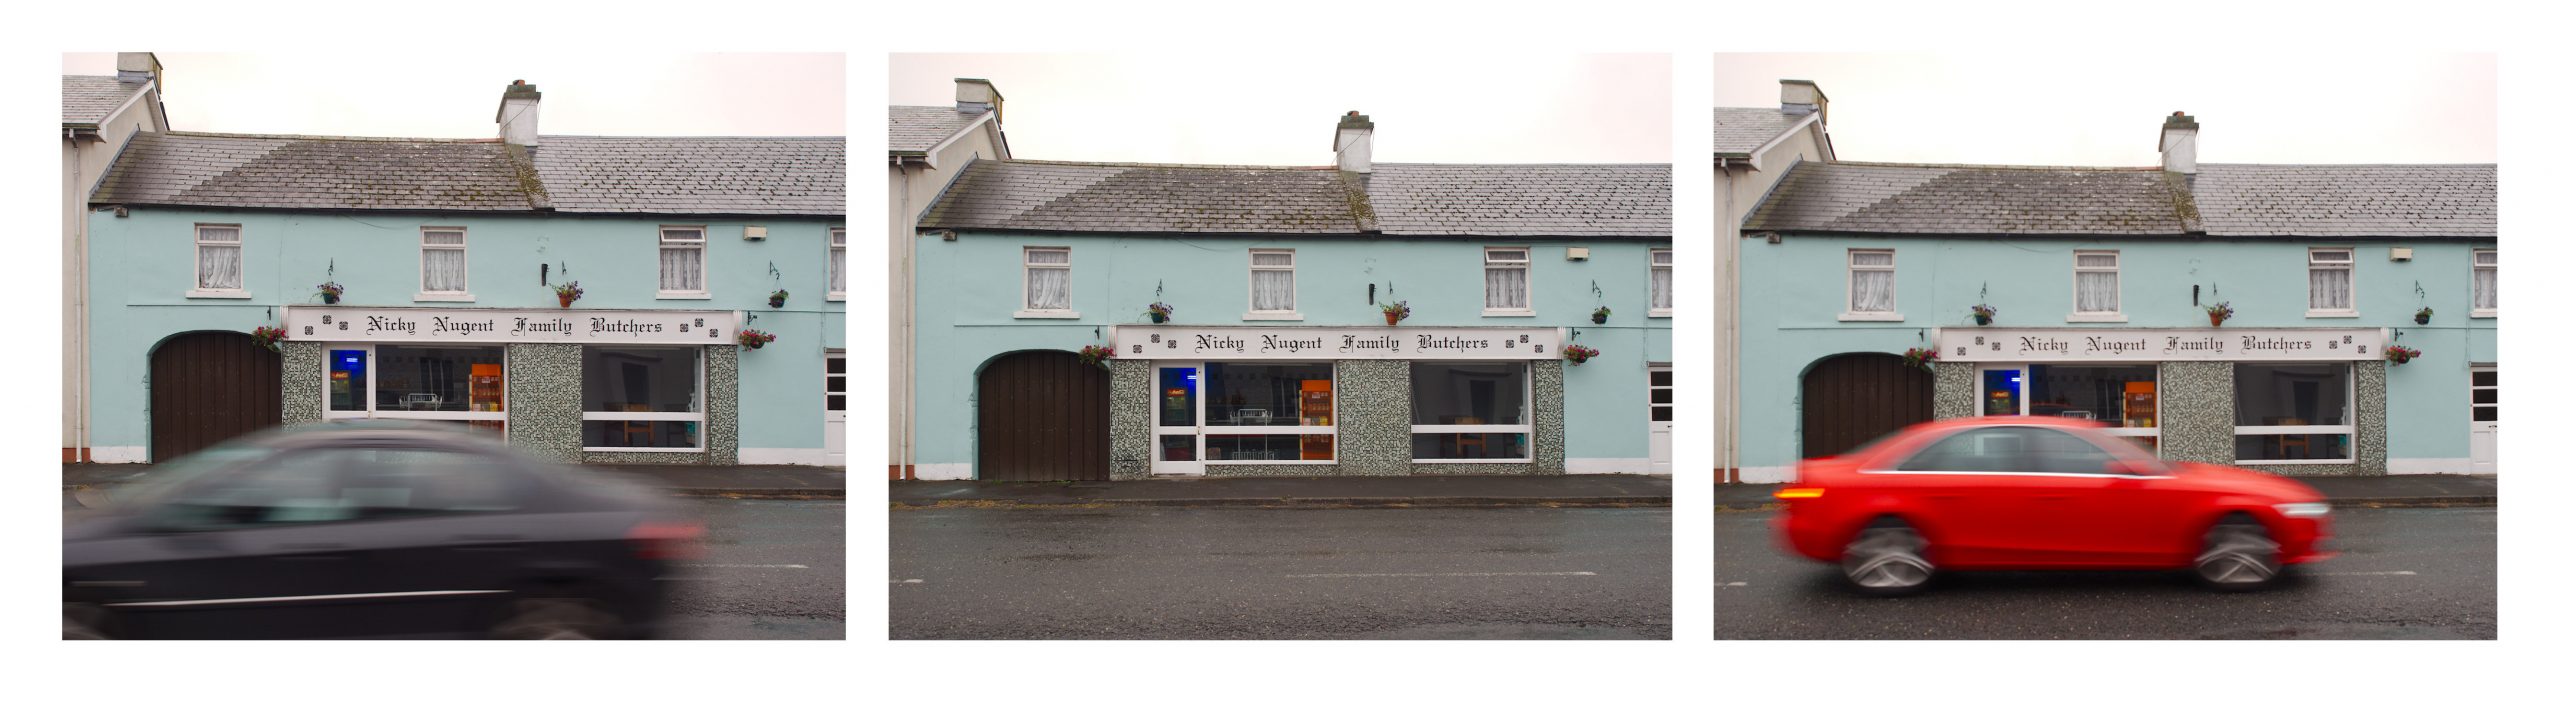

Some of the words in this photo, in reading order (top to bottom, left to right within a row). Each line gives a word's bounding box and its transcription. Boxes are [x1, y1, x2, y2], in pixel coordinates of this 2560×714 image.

[366, 316, 416, 336] Nicky
[432, 316, 494, 336] Nugent
[511, 316, 573, 336] Family
[589, 316, 663, 337] Butchers
[1194, 335, 1245, 353] Nicky
[1261, 334, 1322, 353] Nugent
[1339, 334, 1400, 353] Family
[1417, 334, 1489, 353] Butchers
[2020, 336, 2069, 353] Nicky
[2086, 336, 2146, 354] Nugent
[2165, 336, 2223, 354] Family
[2241, 335, 2312, 354] Butchers
